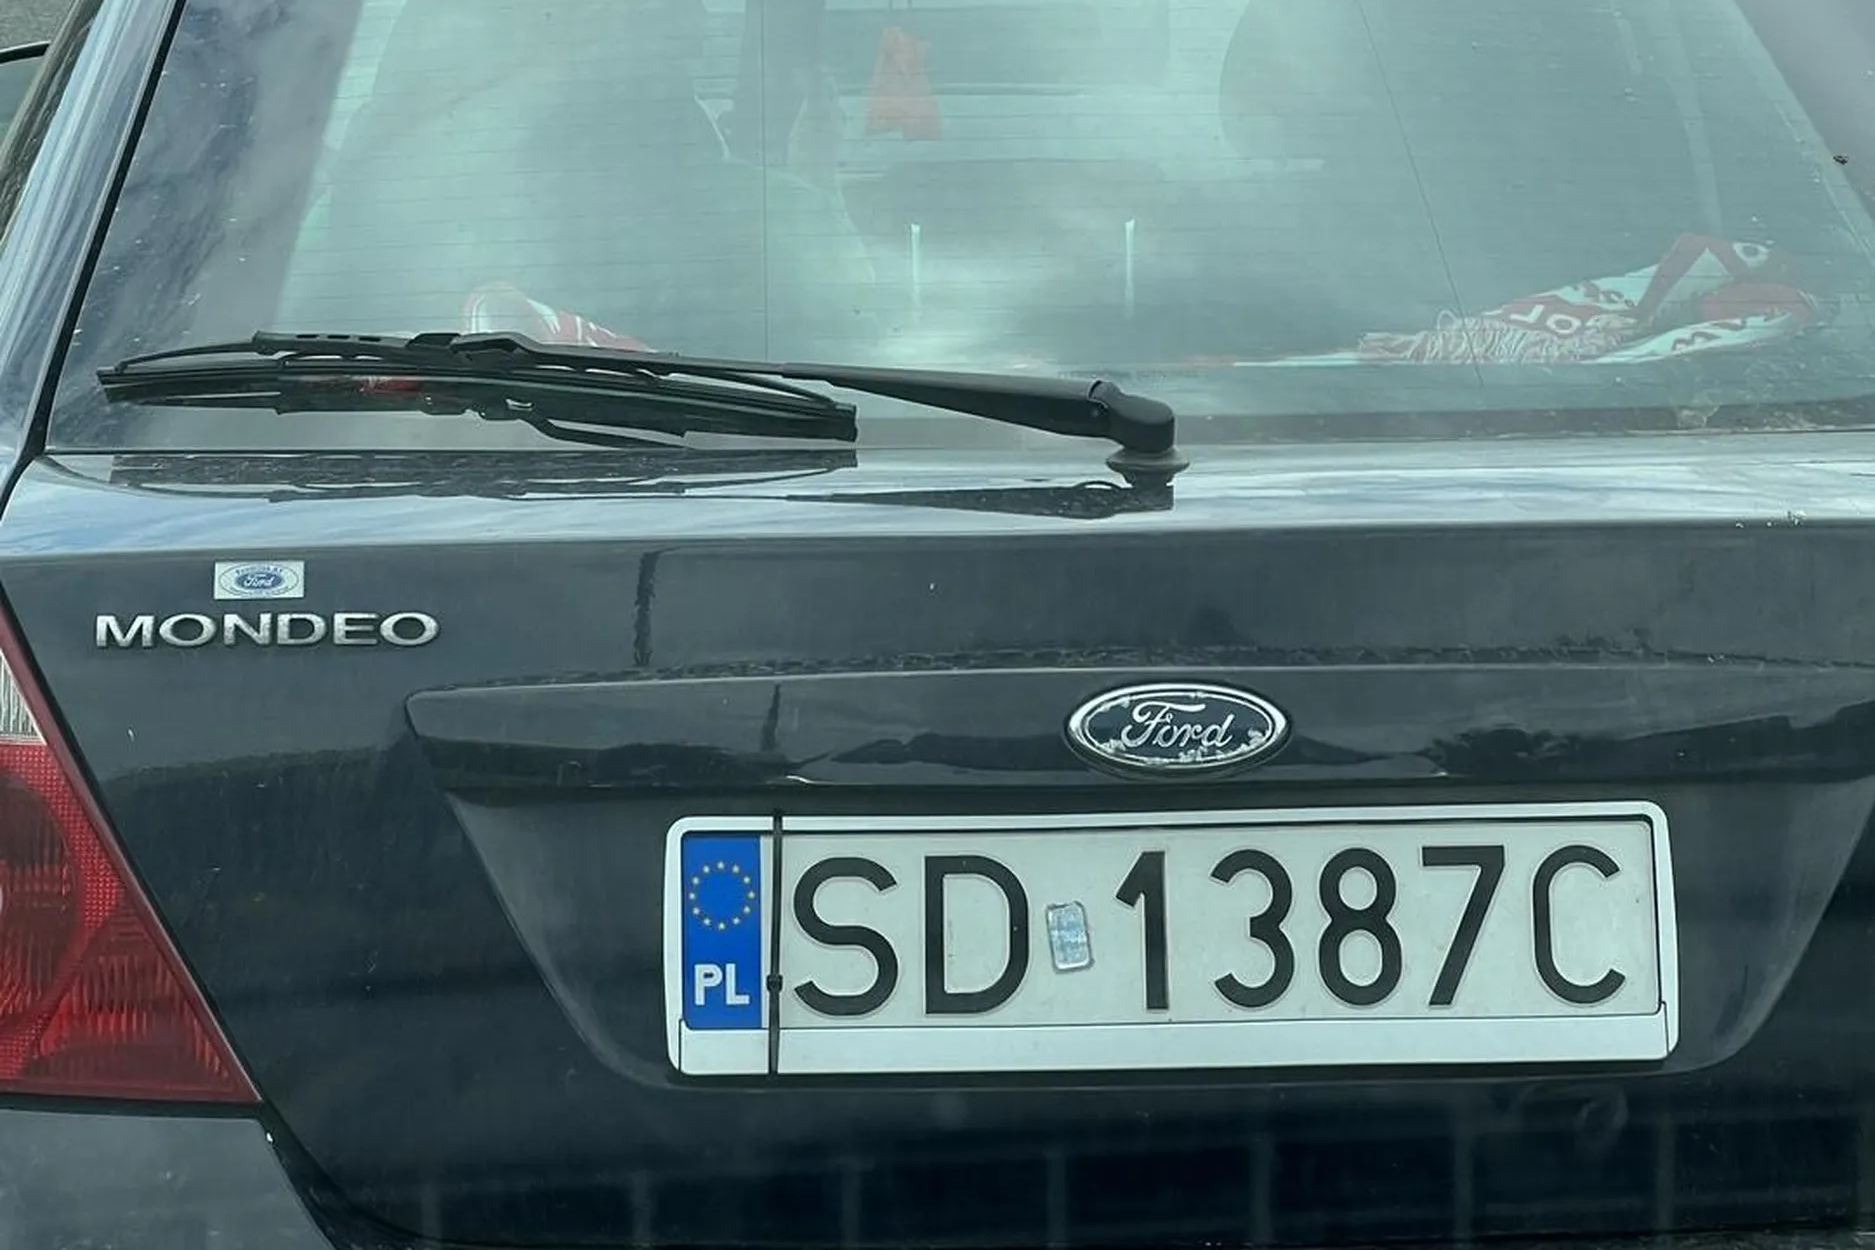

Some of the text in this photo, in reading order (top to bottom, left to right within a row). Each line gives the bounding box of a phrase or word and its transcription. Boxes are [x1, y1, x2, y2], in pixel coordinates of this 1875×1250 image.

[95, 612, 440, 648] MONDEO
[1121, 700, 1236, 748] Ford
[793, 844, 1626, 1016] SD 1387C
[694, 962, 750, 1006] PL
